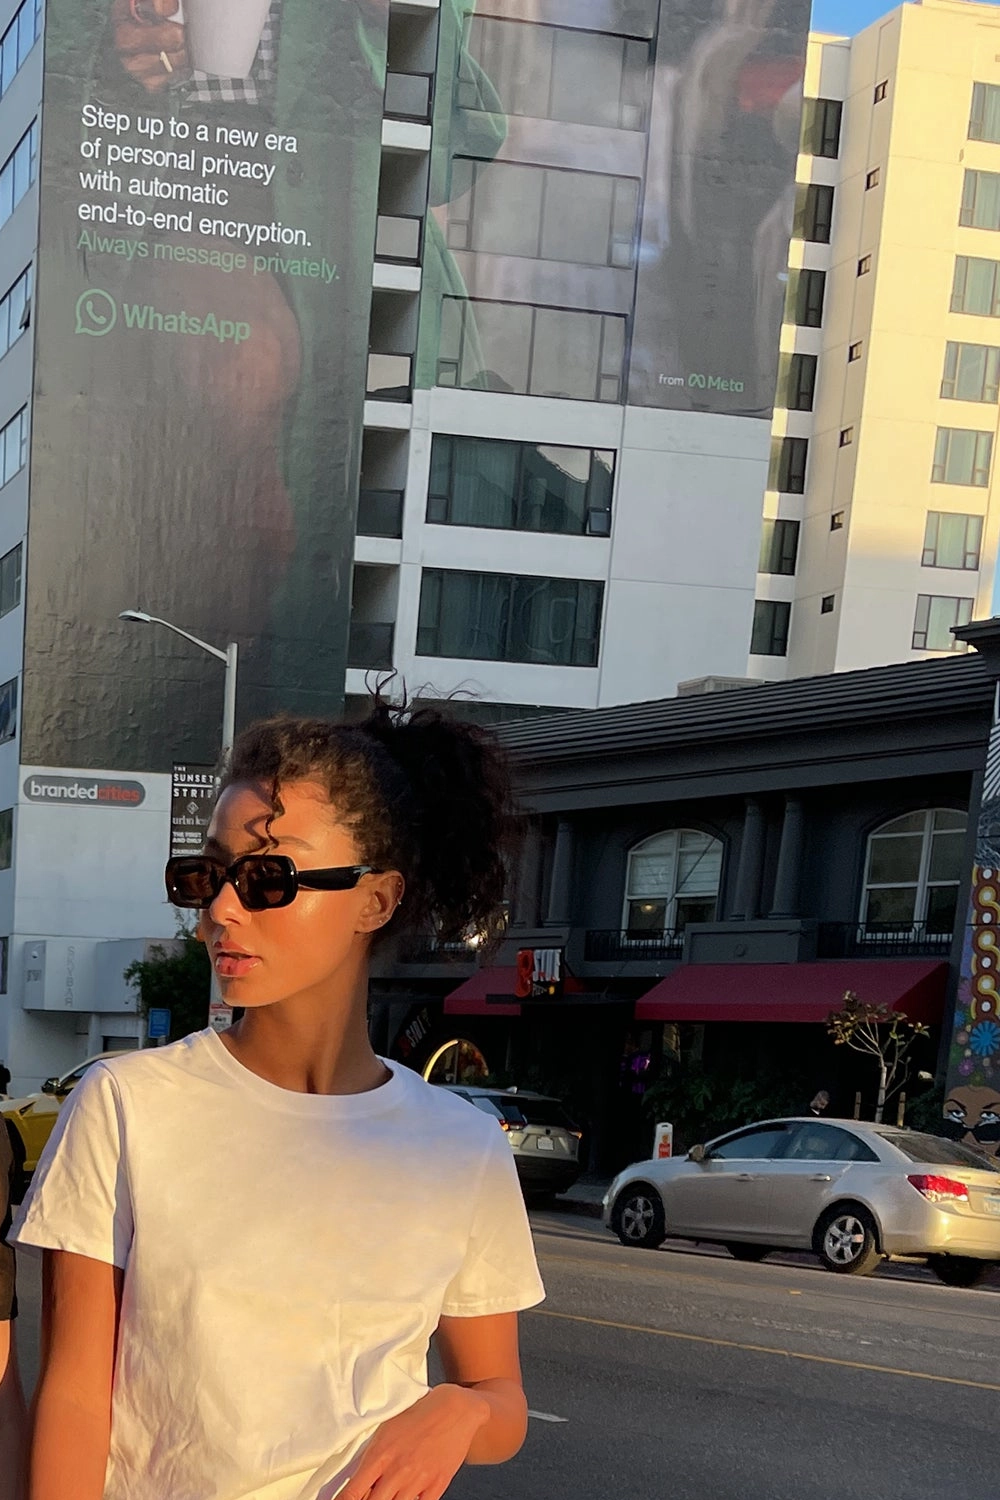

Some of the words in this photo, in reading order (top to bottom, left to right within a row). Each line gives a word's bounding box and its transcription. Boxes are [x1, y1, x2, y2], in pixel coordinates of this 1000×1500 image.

[81, 104, 130, 135] Step
[137, 116, 164, 140] up
[169, 116, 190, 139] to
[196, 124, 209, 142] a
[216, 126, 259, 147] new
[264, 133, 298, 153] era
[80, 138, 102, 158] of
[107, 143, 195, 171] personal
[202, 154, 276, 185] privacy
[79, 169, 122, 193] with
[128, 177, 229, 206] automatic
[78, 202, 193, 232] end-to-end
[199, 217, 312, 247] encryption.
[77, 229, 149, 261] Always
[154, 242, 247, 273] message
[253, 252, 341, 284] privately.
[122, 303, 250, 345] WhatsApp
[658, 373, 684, 386] from
[707, 376, 744, 392] Meta
[173, 773, 214, 783] SUNSET
